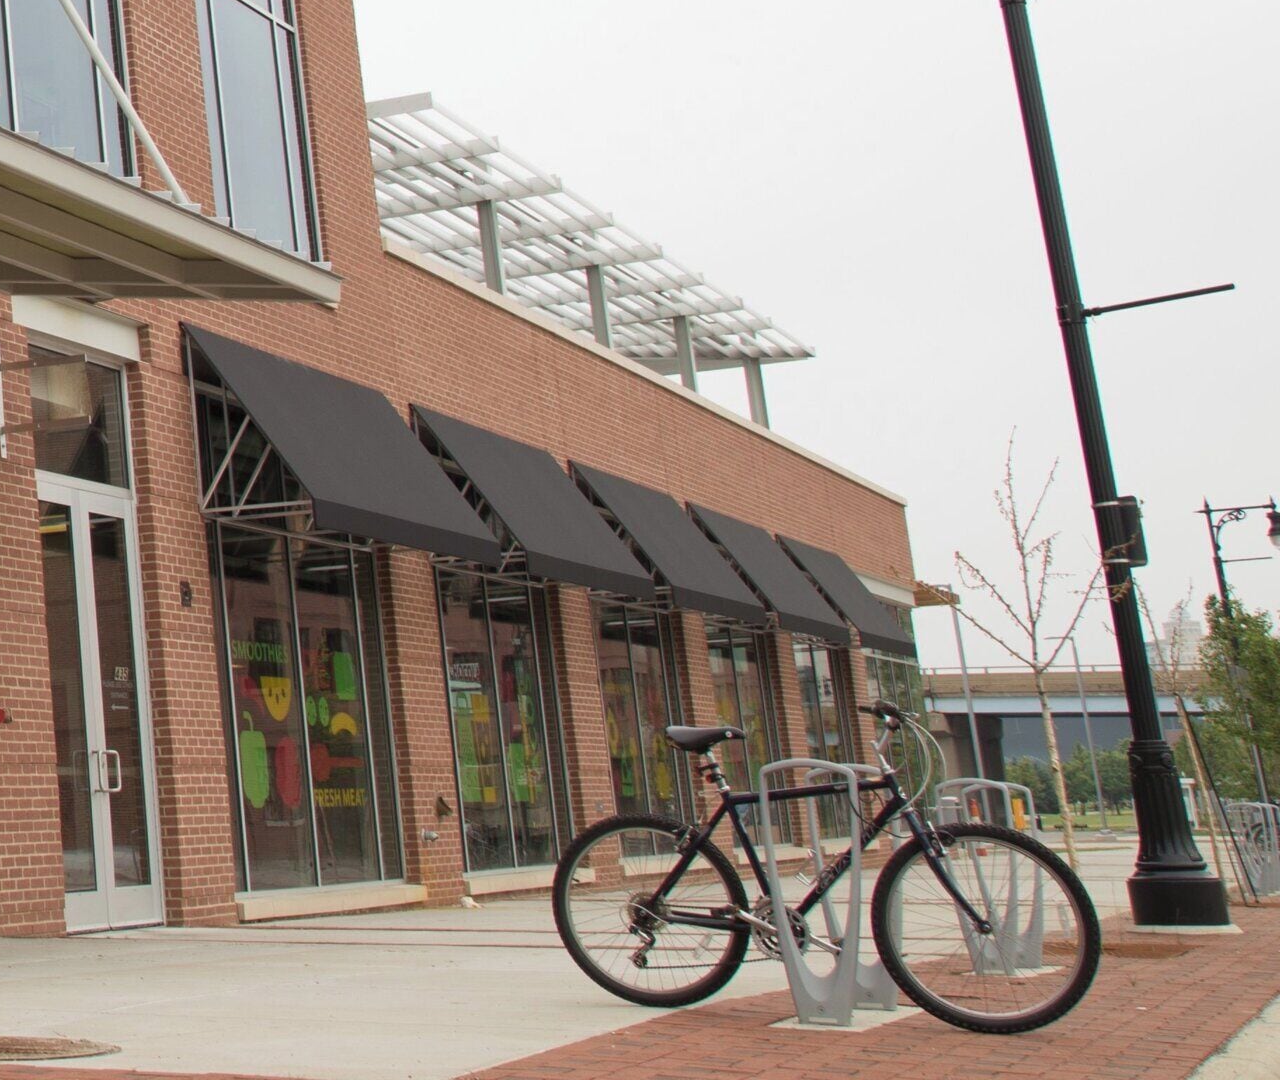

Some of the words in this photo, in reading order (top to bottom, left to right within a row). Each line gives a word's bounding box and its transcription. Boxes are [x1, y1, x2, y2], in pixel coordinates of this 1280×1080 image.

[232, 640, 289, 664] SMOOTHIES
[314, 788, 342, 808] FRESH
[342, 787, 366, 807] MEAT
